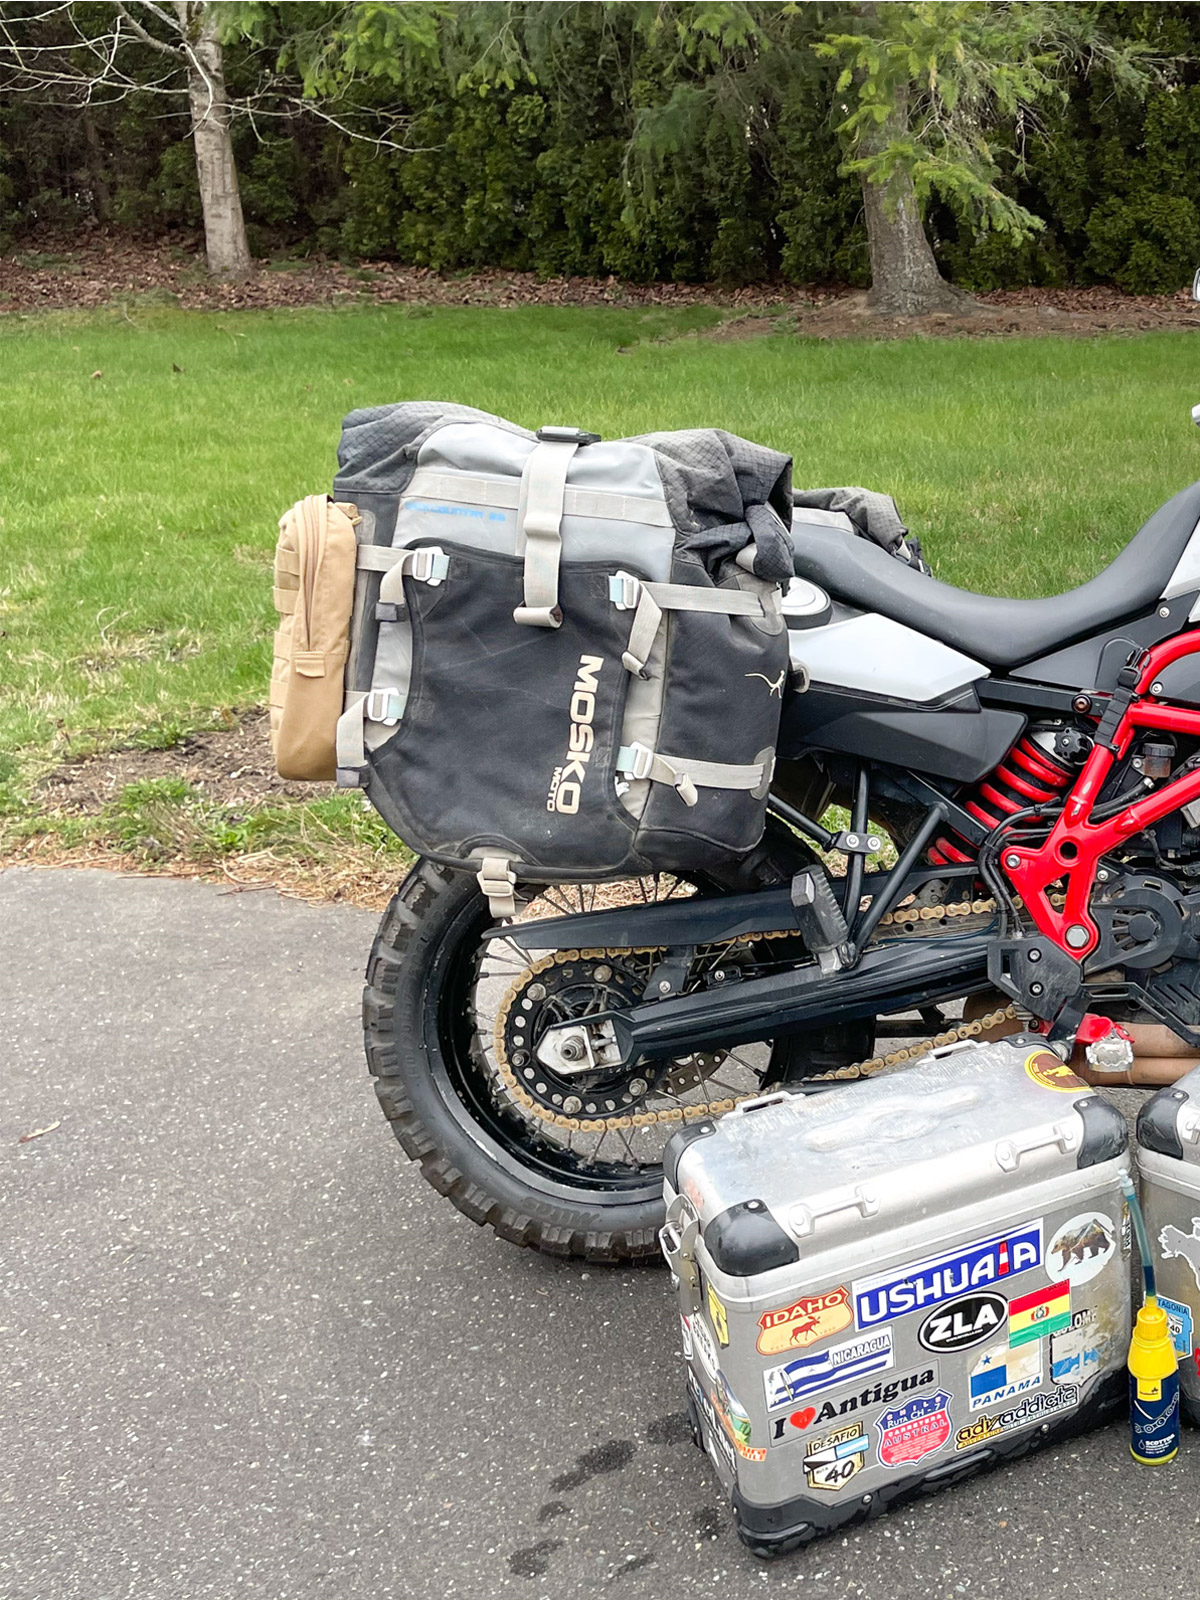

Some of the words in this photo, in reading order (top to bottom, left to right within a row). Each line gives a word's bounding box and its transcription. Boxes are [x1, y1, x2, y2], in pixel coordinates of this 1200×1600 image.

[555, 654, 605, 815] MOSKO
[546, 766, 563, 813] MOTO
[859, 1239, 1038, 1323] USHUAIA
[765, 1293, 843, 1328] IDAHO
[928, 1303, 999, 1343] ZLA
[1157, 1298, 1189, 1316] TAGONIA
[1169, 1324, 1181, 1334] 40
[831, 1334, 891, 1366] NICARAGUA
[773, 1417, 787, 1440] I
[813, 1368, 935, 1425] Antigua
[972, 1375, 1041, 1409] PANAMA
[886, 1396, 942, 1421] CHILE
[813, 1427, 858, 1452] DESAFIO
[883, 1420, 948, 1448] AUSTRAL
[888, 1413, 943, 1437] CARRETERA
[824, 1459, 856, 1484] 40
